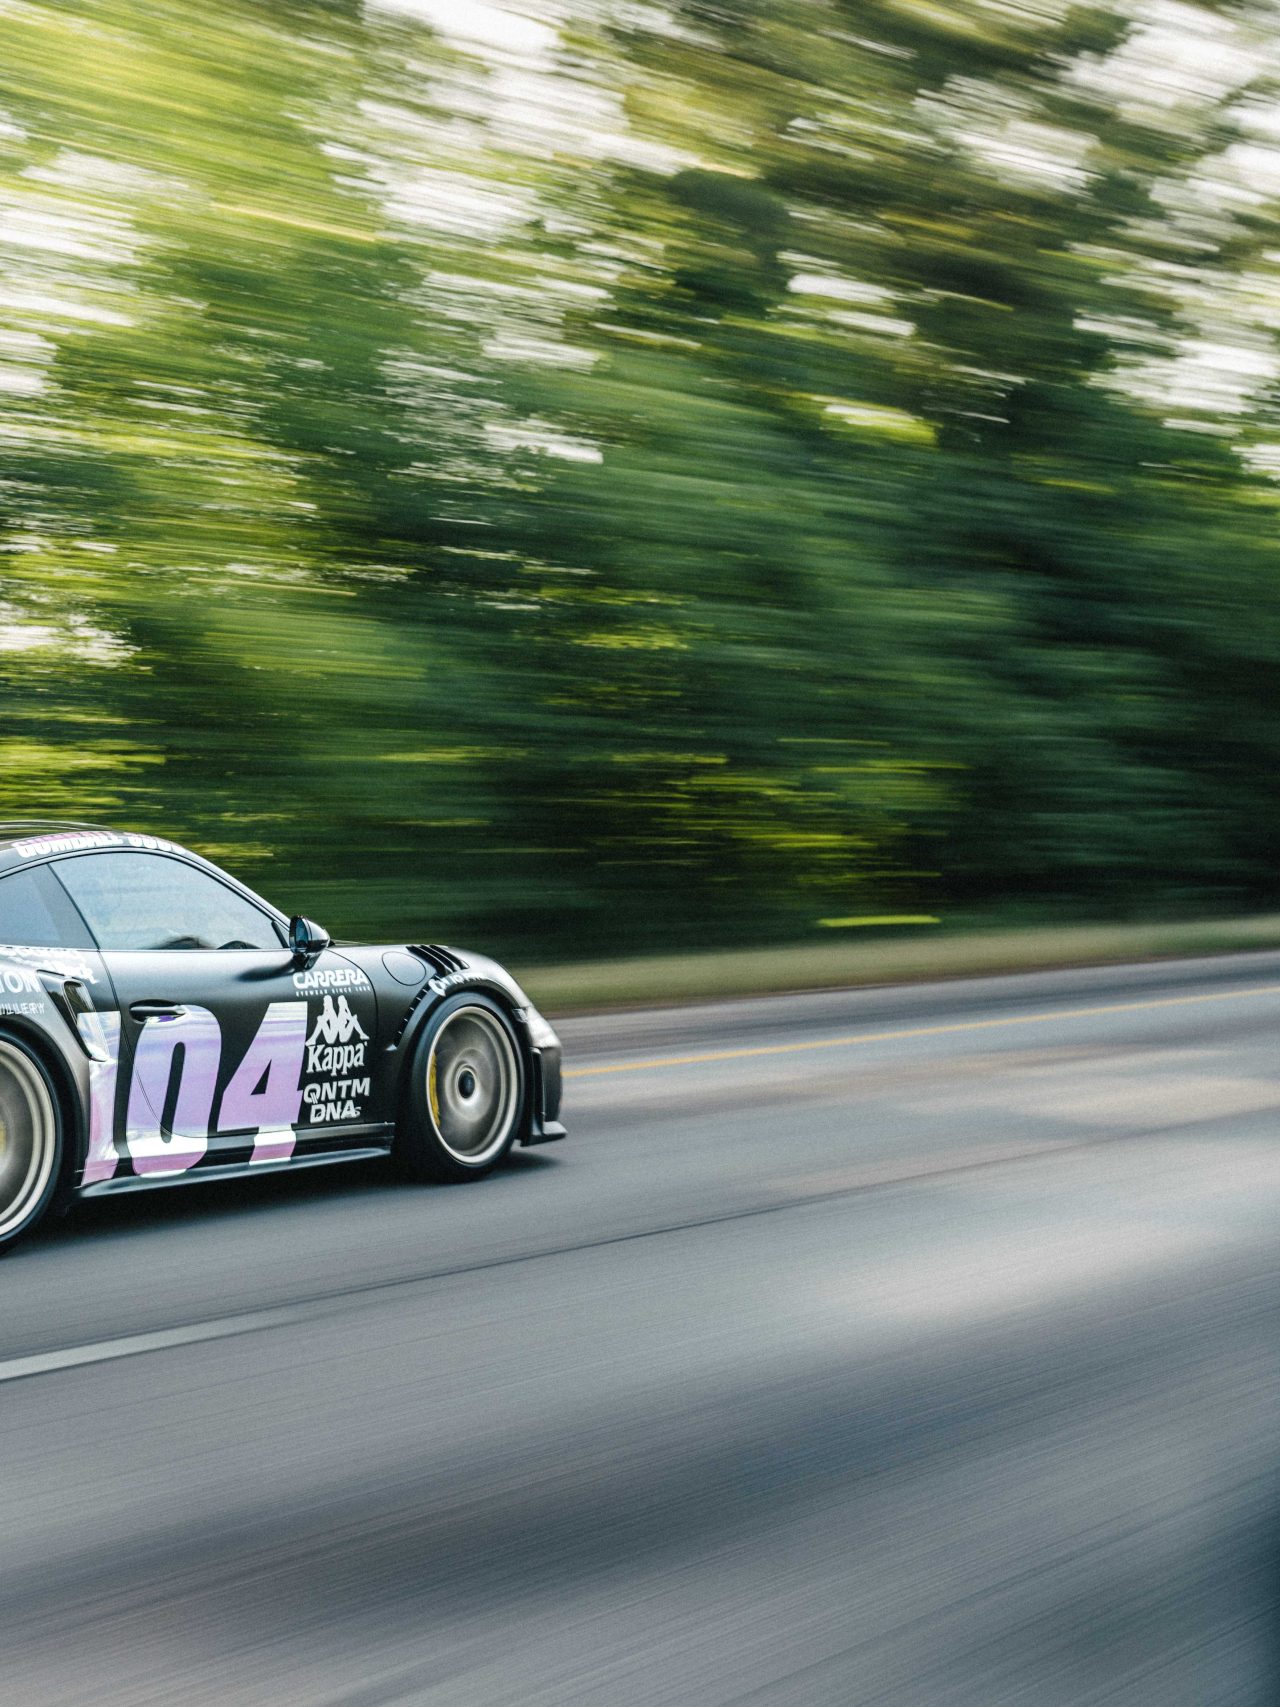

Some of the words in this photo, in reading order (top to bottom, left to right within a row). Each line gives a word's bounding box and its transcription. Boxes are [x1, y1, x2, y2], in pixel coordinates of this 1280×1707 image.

[292, 968, 369, 989] CARRERA
[306, 1043, 365, 1077] Kappa
[303, 1077, 371, 1104] QNTM
